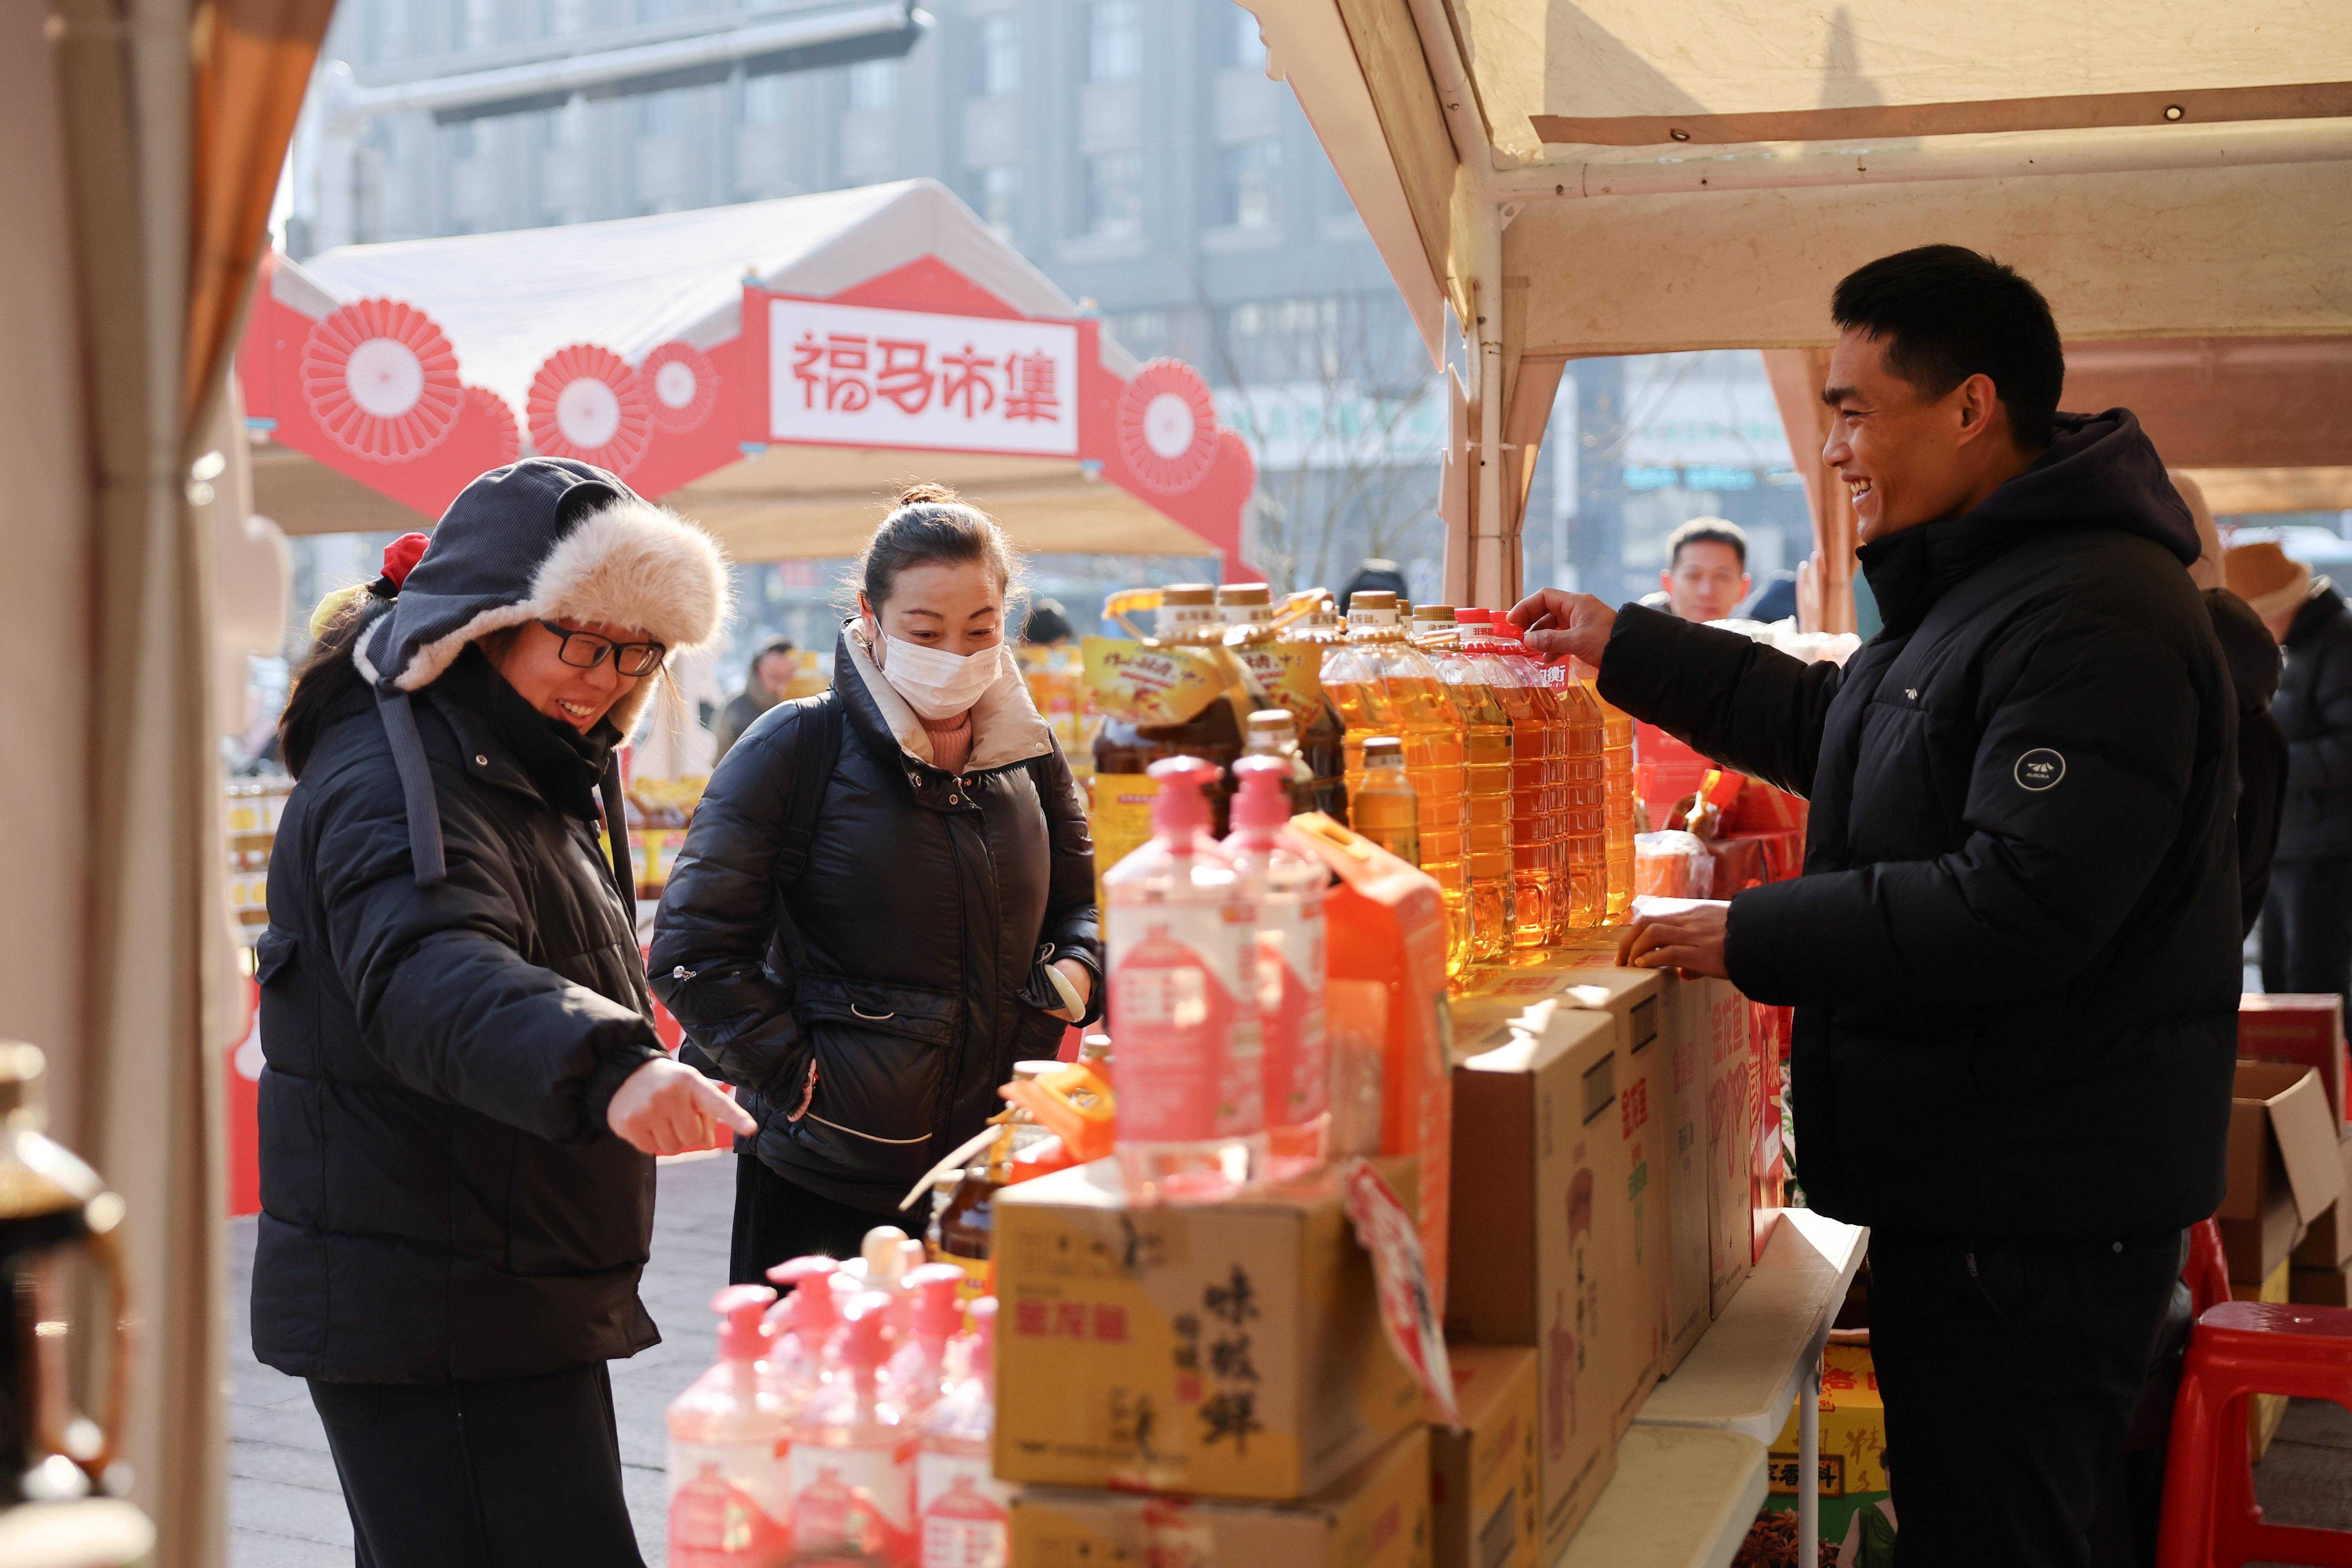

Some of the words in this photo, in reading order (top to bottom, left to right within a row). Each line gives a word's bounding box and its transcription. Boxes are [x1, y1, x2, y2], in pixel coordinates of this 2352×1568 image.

[792, 328, 1060, 423] 福马市集
[1711, 992, 1744, 1066] 金龙鱼
[1621, 1076, 1648, 1140] 金龙鱼
